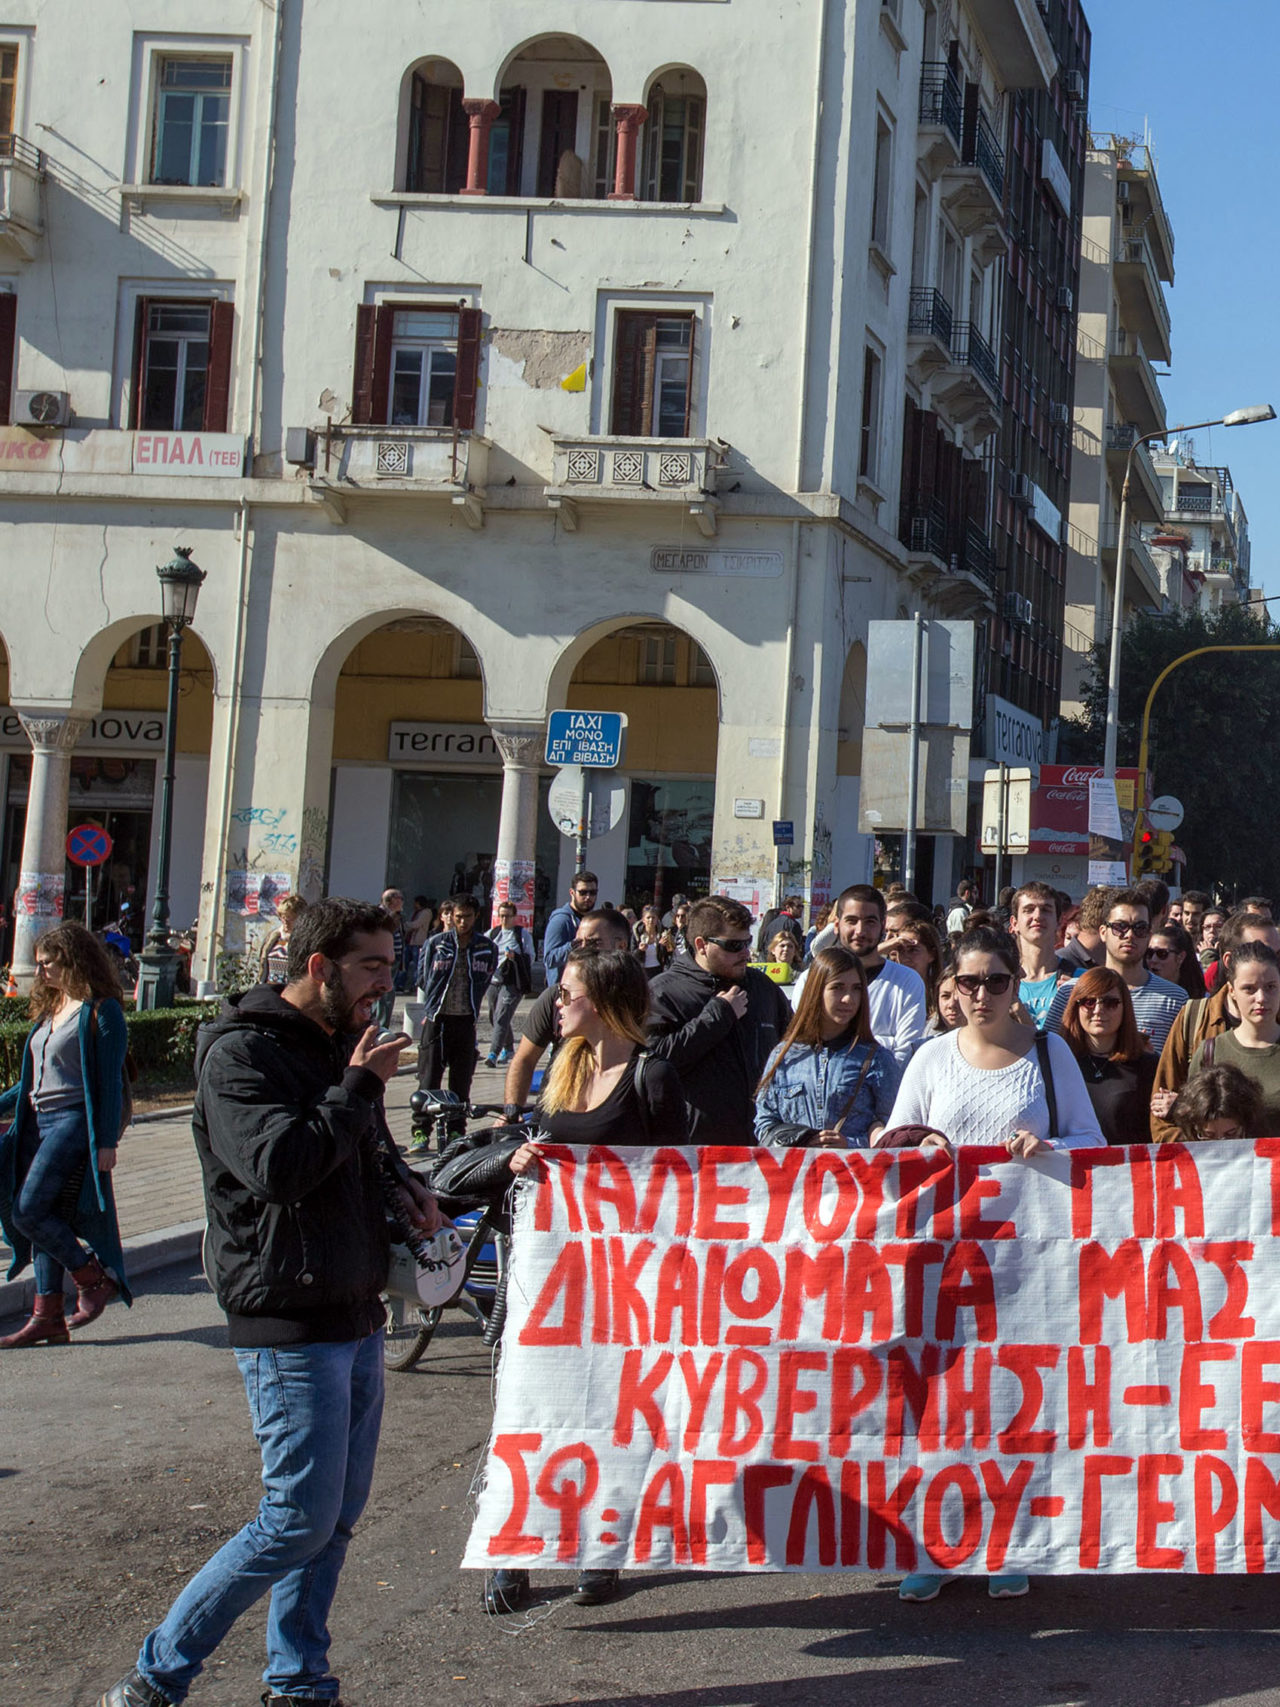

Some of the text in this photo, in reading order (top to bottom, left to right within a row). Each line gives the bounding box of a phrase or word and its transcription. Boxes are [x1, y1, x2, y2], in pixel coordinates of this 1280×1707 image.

[136, 436, 204, 464] ΕΠΑΛ
[209, 451, 241, 466] (ΤΕΕ)
[656, 553, 708, 569] ΜΕΓΑΡΟΝ
[394, 732, 496, 753] Terran
[565, 729, 604, 741] ΜΟΝΟ
[552, 739, 613, 753] ΕΠΙΙΒΑΣΗ
[548, 751, 615, 764] ΑΠΒΙΒΑΣΗ
[527, 1144, 1016, 1241] ΠΑΛΕΥΟΥΜΕ
[1070, 1142, 1204, 1239] ΓΙΑ
[518, 1239, 998, 1346] ΔΙΚΑΙΩΜΑΤΑ
[1078, 1240, 1255, 1344] ΜΑΣ
